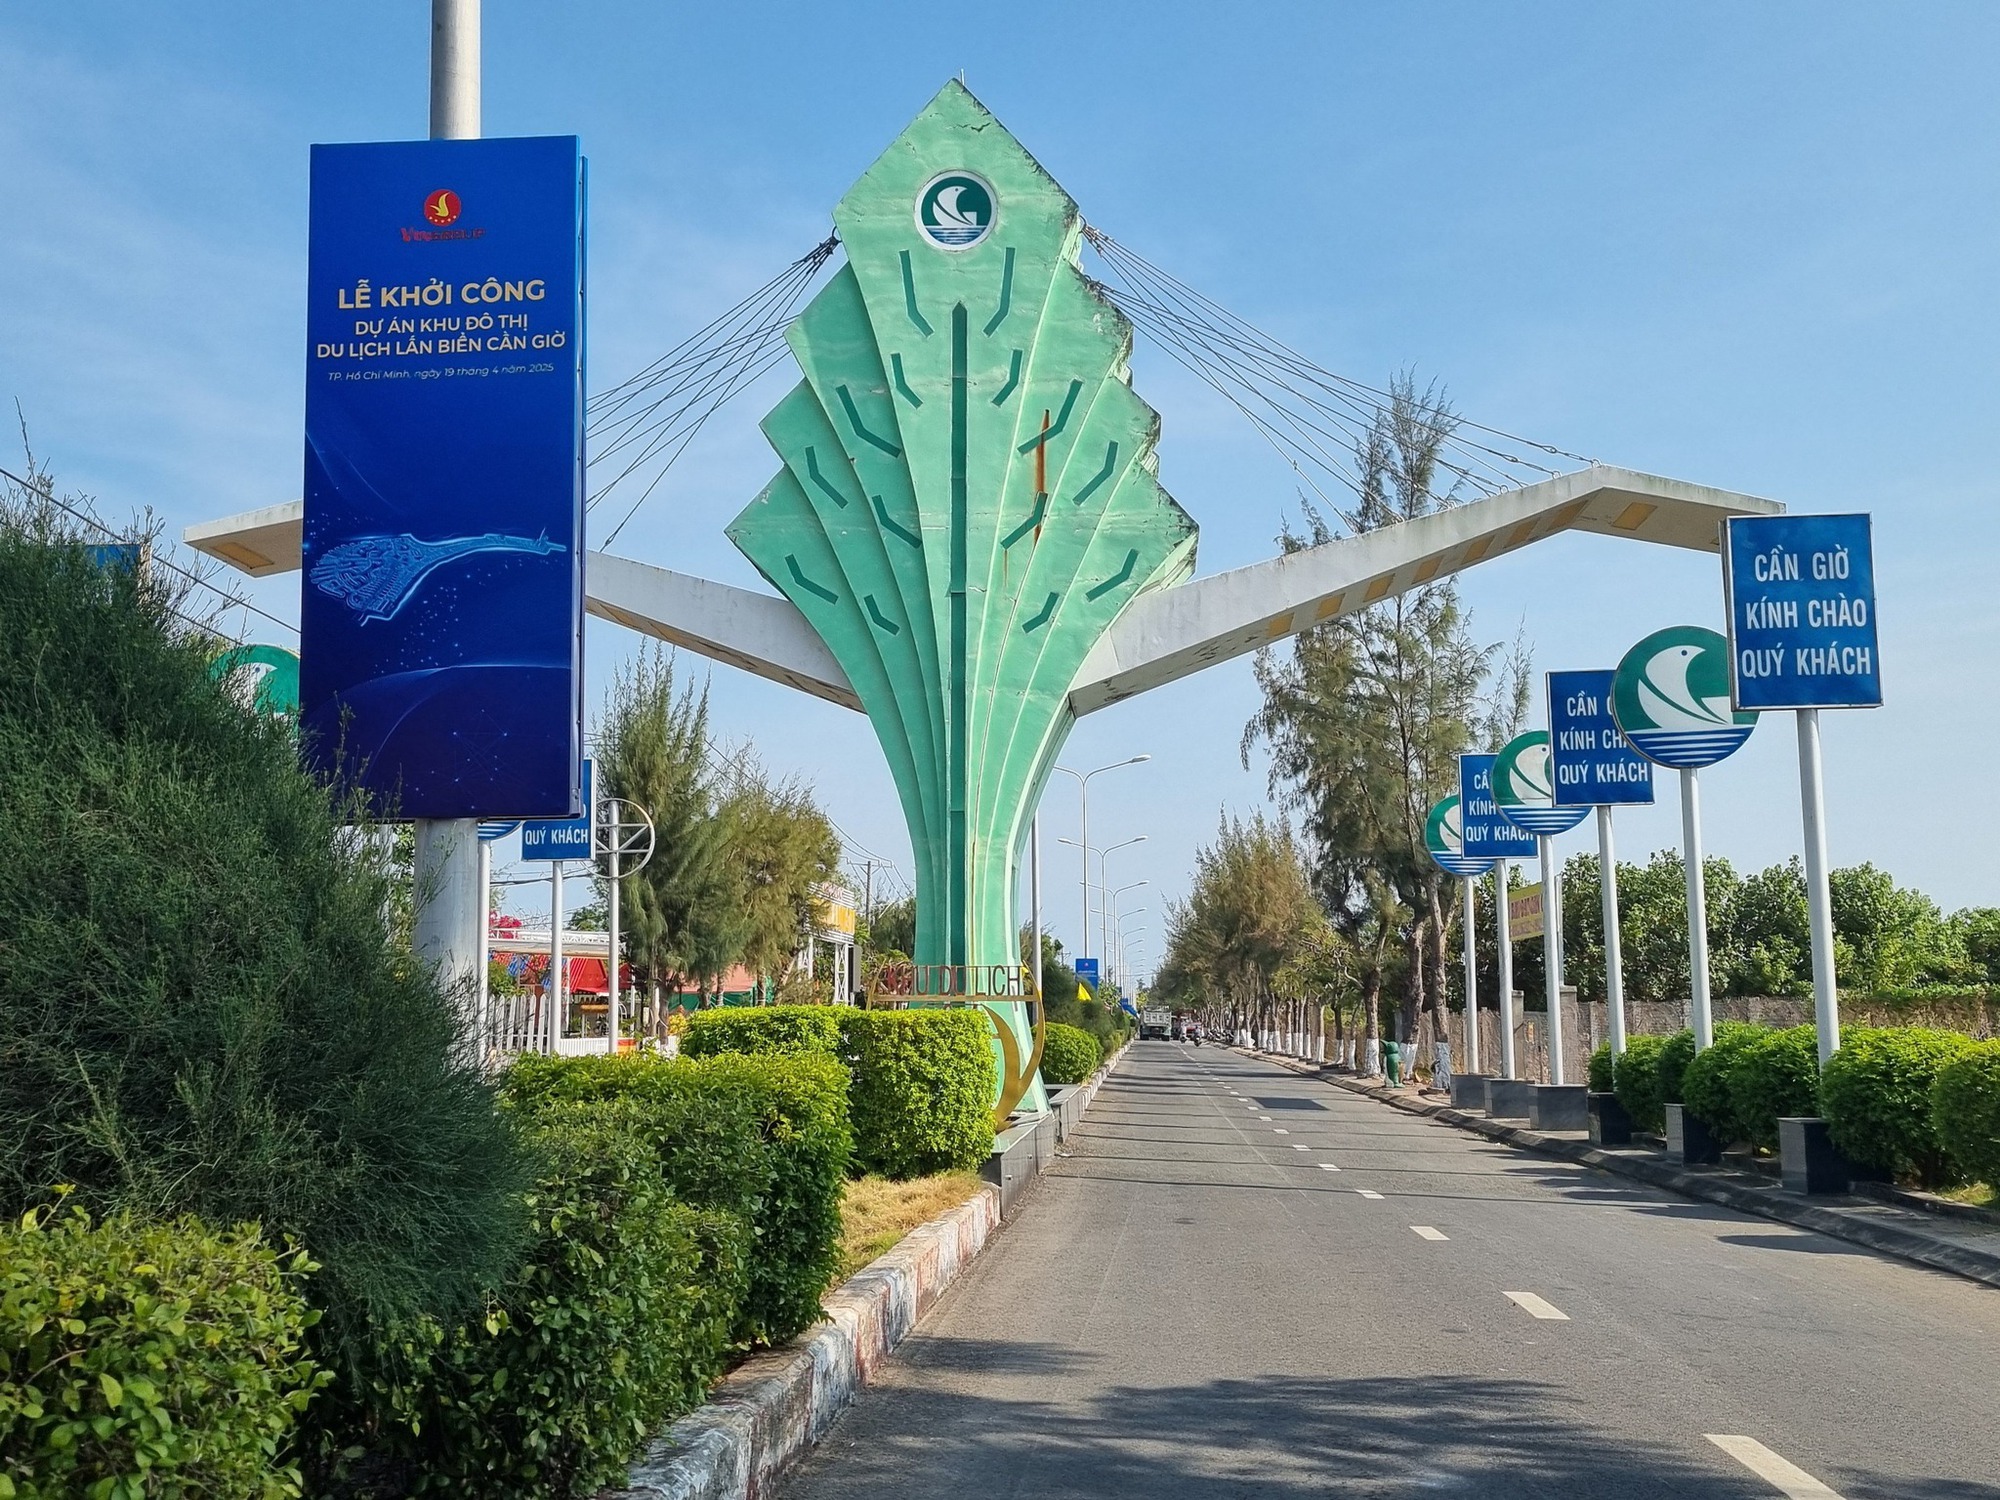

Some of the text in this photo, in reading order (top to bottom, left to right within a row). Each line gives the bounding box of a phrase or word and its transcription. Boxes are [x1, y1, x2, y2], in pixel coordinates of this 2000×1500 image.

[338, 277, 545, 309] LỄ KHỞI CÔNG
[355, 312, 528, 338] DỰ ÁN KHU ĐÔ THỊ
[317, 330, 565, 360] DU LỊCH LẤN BIỂN CẦN GIỜ
[328, 372, 343, 381] TP.
[444, 367, 455, 377] 19
[492, 365, 499, 374] 4
[528, 363, 554, 373] 2025
[1754, 544, 1849, 582] CẦN GIỜ
[1745, 592, 1867, 629] KÍNH CHÀO
[1741, 641, 1871, 678] QUÝ KHÁCH
[1567, 690, 1597, 717] CẦN
[1560, 726, 1596, 751] KÍNH
[1560, 758, 1648, 785] QUÝ KHÁCH
[1469, 797, 1496, 816] KÍNH
[525, 826, 588, 845] QUÝ KHÁCH
[1466, 823, 1489, 842] QUÝ
